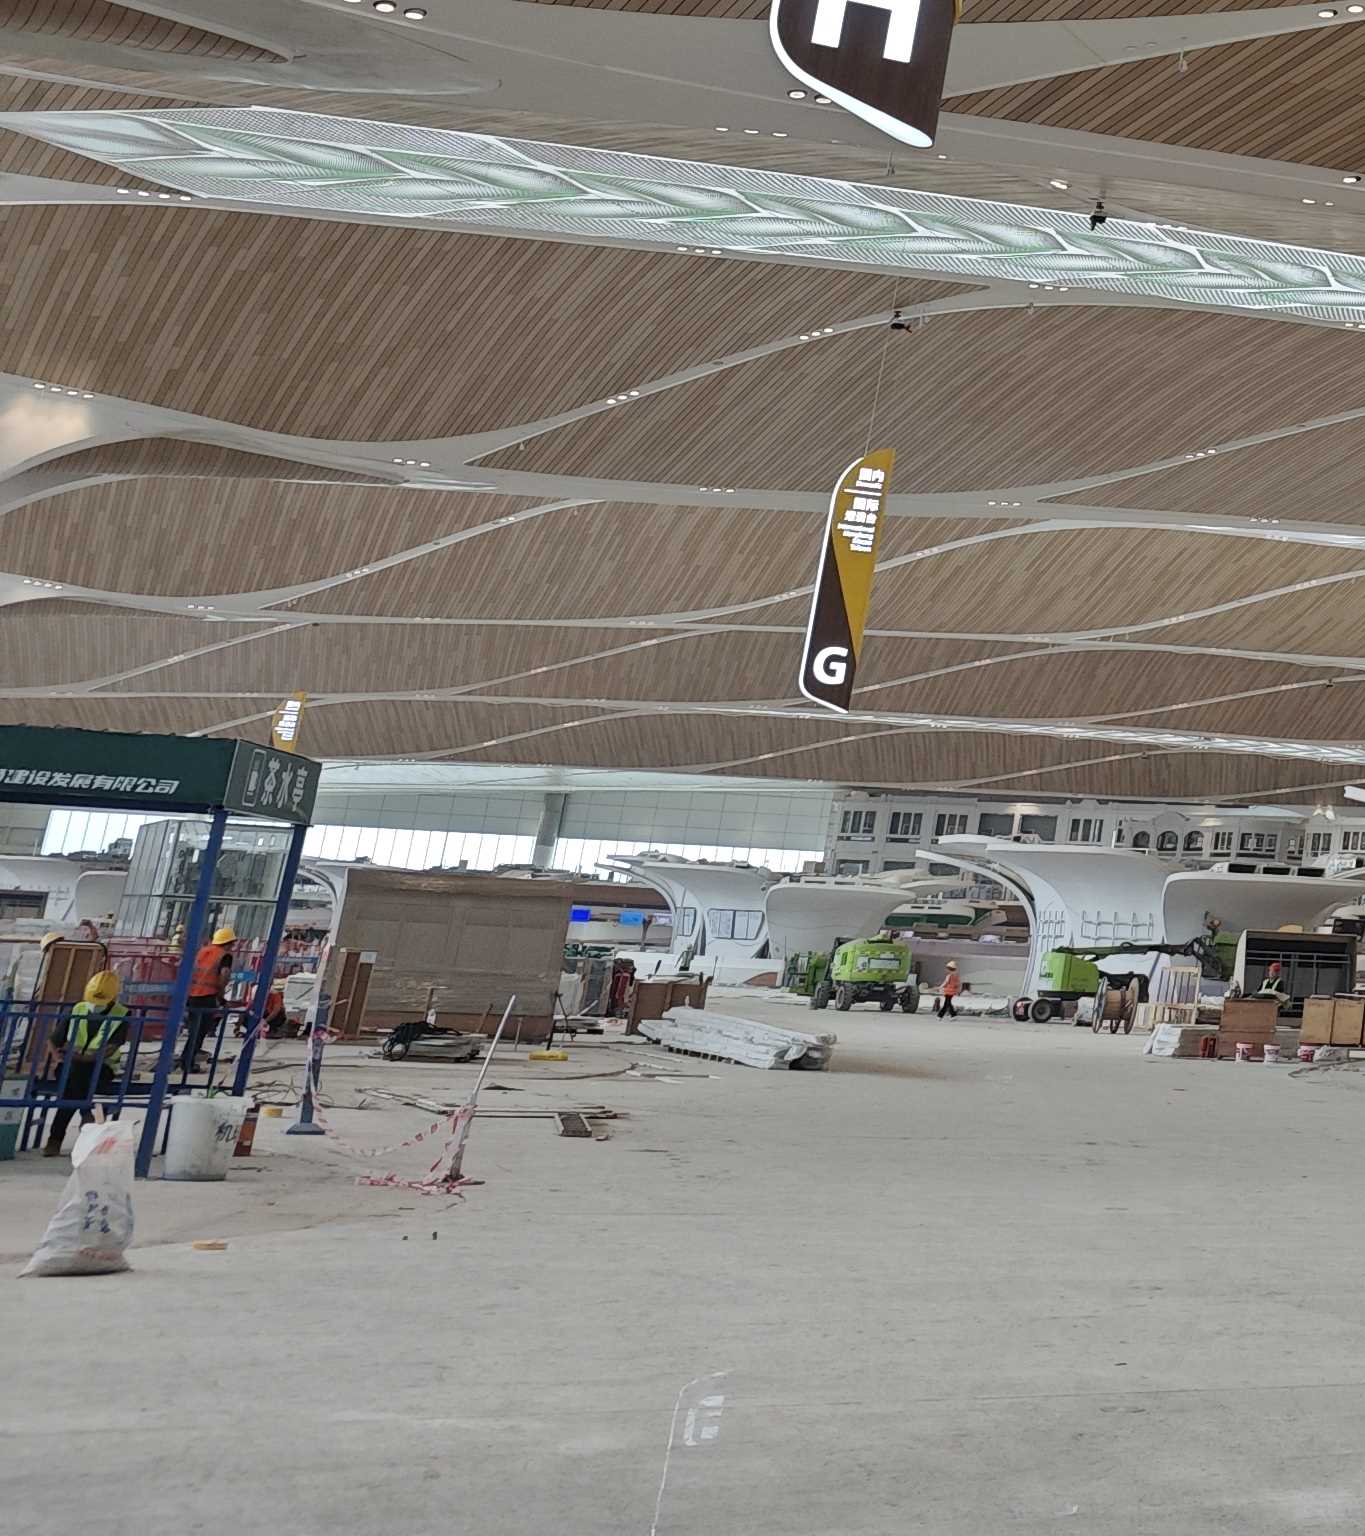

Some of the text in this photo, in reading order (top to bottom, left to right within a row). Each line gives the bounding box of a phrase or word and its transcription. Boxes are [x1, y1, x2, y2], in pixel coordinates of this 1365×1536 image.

[813, 646, 849, 685] G
[0, 768, 180, 796] 建设发展有限公司
[260, 757, 308, 812] 茶水亭
